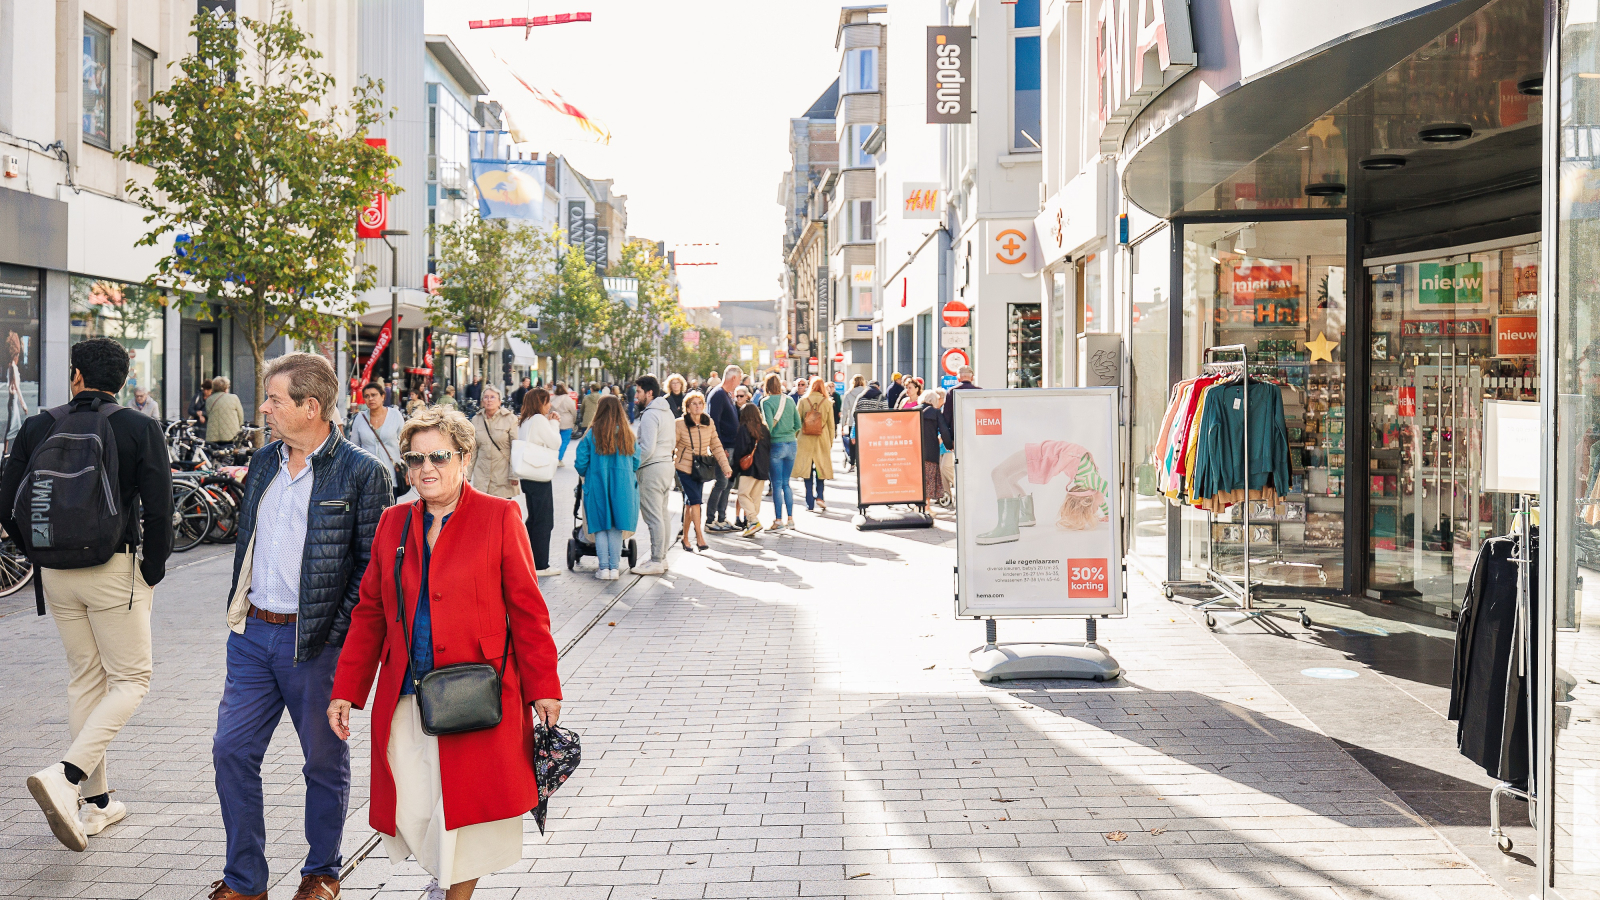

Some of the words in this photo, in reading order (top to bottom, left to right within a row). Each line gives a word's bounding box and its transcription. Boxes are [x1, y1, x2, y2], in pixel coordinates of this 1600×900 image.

[936, 44, 966, 115] snipes
[905, 189, 938, 212] H&M
[1421, 275, 1481, 290] nieuw
[1499, 329, 1538, 341] nieuw
[1400, 398, 1415, 406] HEMA
[976, 418, 1001, 426] HEMA
[31, 478, 54, 522] PUMA
[1017, 558, 1060, 566] regenlaarzen
[1071, 567, 1105, 581] 30%
[1071, 581, 1104, 592] korting
